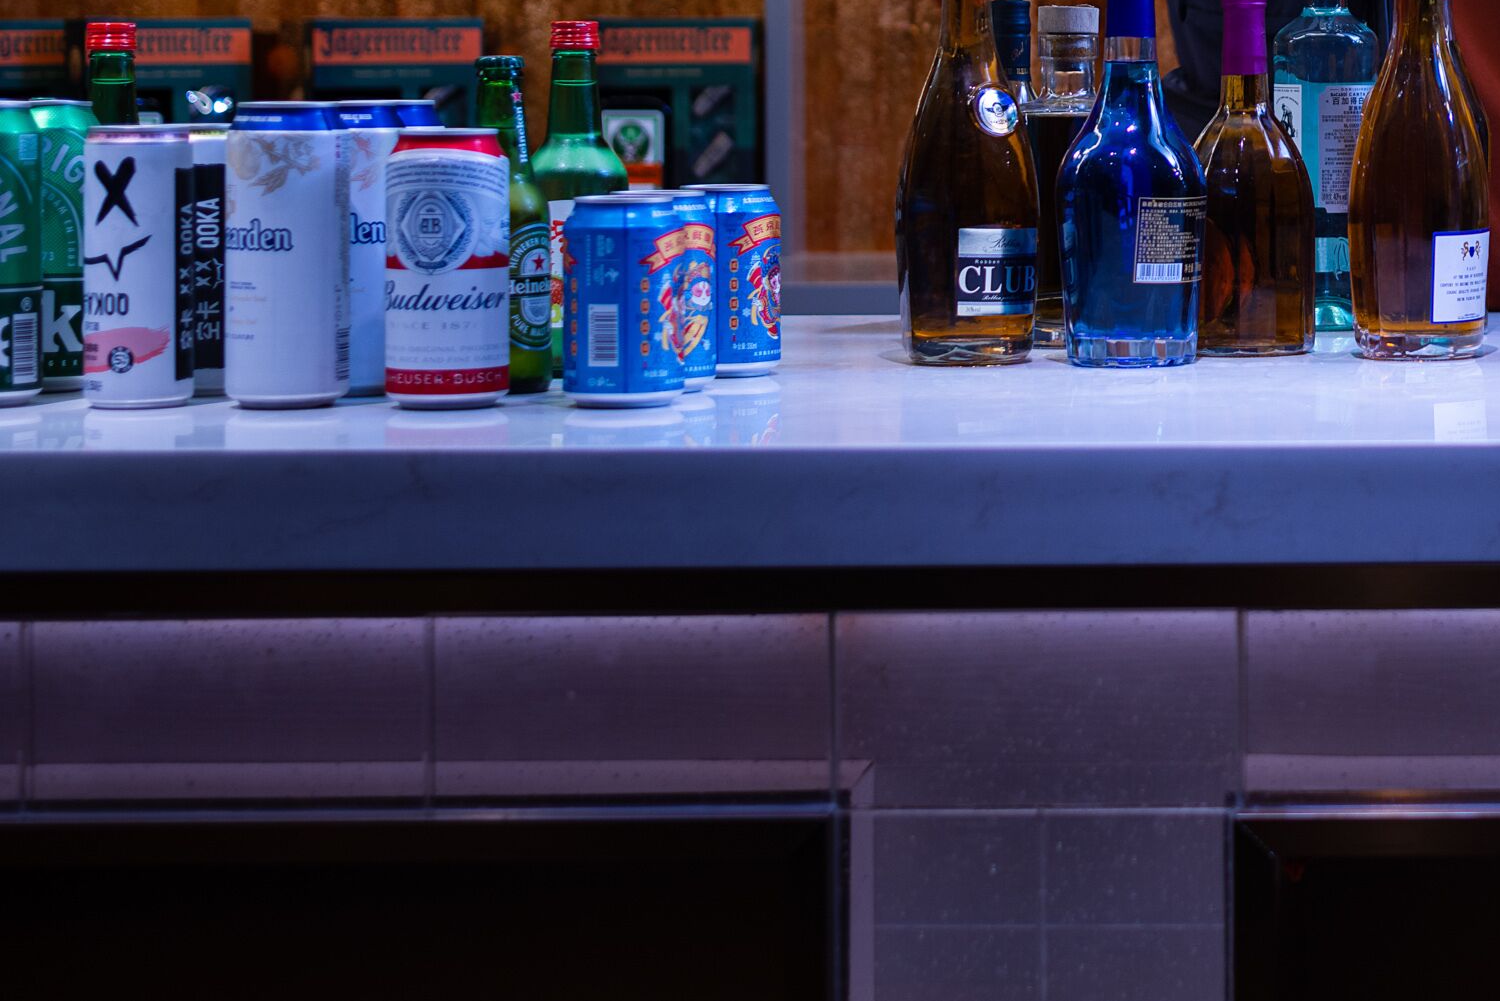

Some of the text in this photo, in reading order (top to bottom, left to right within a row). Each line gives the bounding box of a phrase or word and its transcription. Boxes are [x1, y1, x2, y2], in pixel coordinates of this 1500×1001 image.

[196, 197, 220, 248] QOKA
[958, 265, 1036, 294] CLUB
[385, 280, 506, 311] Budweiser
